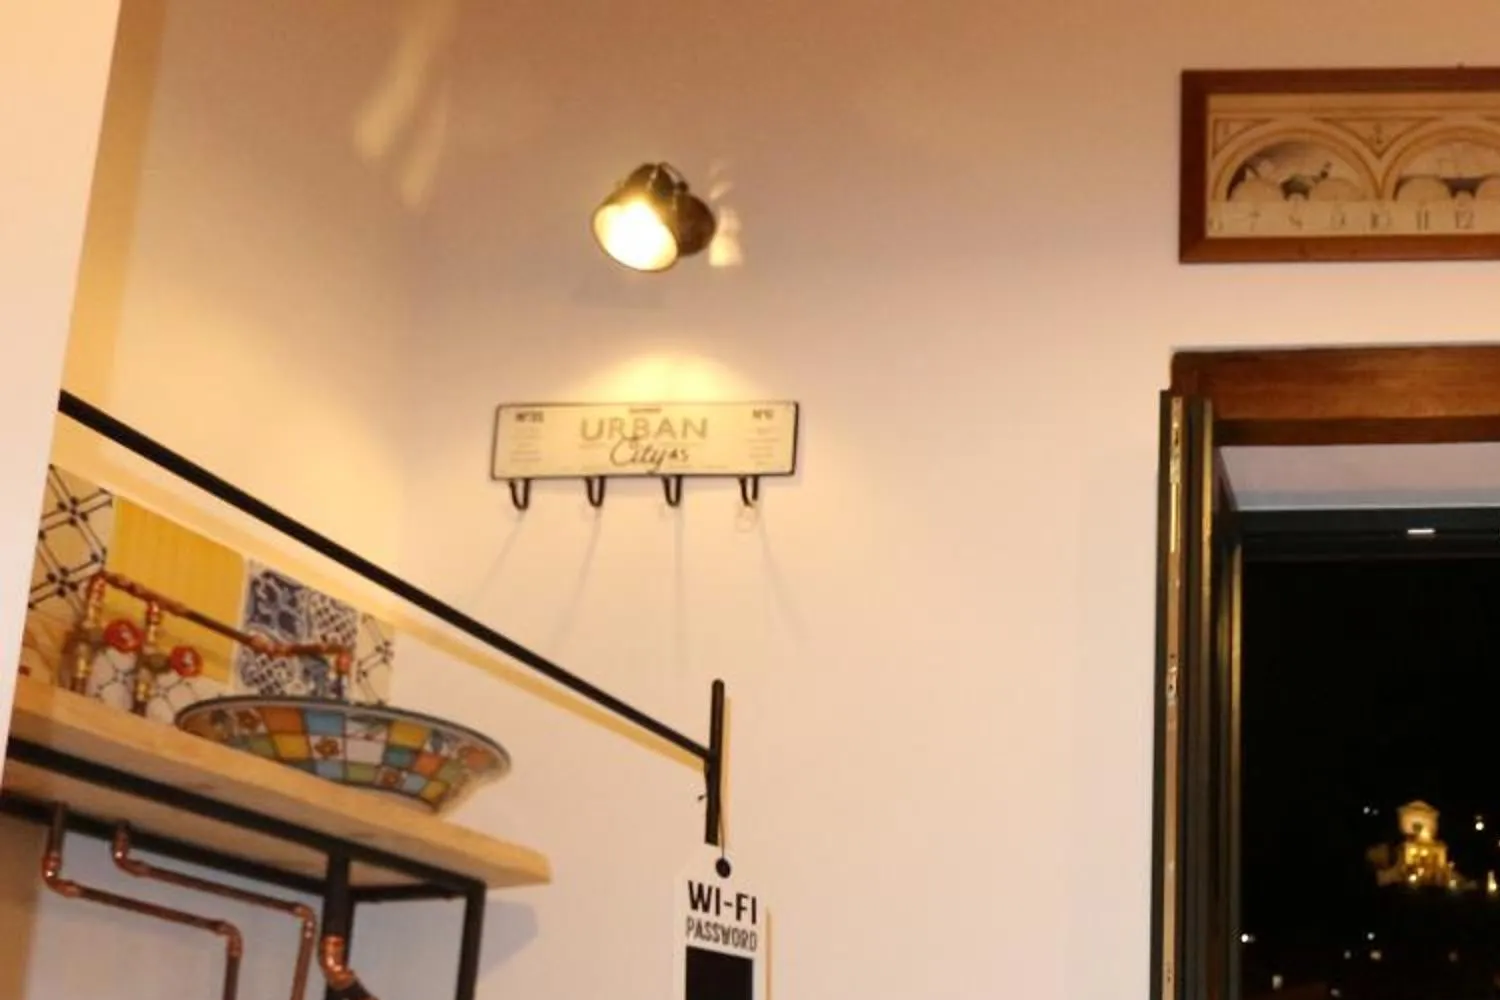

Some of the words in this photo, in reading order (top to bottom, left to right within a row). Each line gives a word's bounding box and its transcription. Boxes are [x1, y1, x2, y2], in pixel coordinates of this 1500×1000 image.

[580, 416, 708, 441] URBAN
[687, 879, 758, 926] WI-FI
[685, 915, 758, 952] PASSWORD
